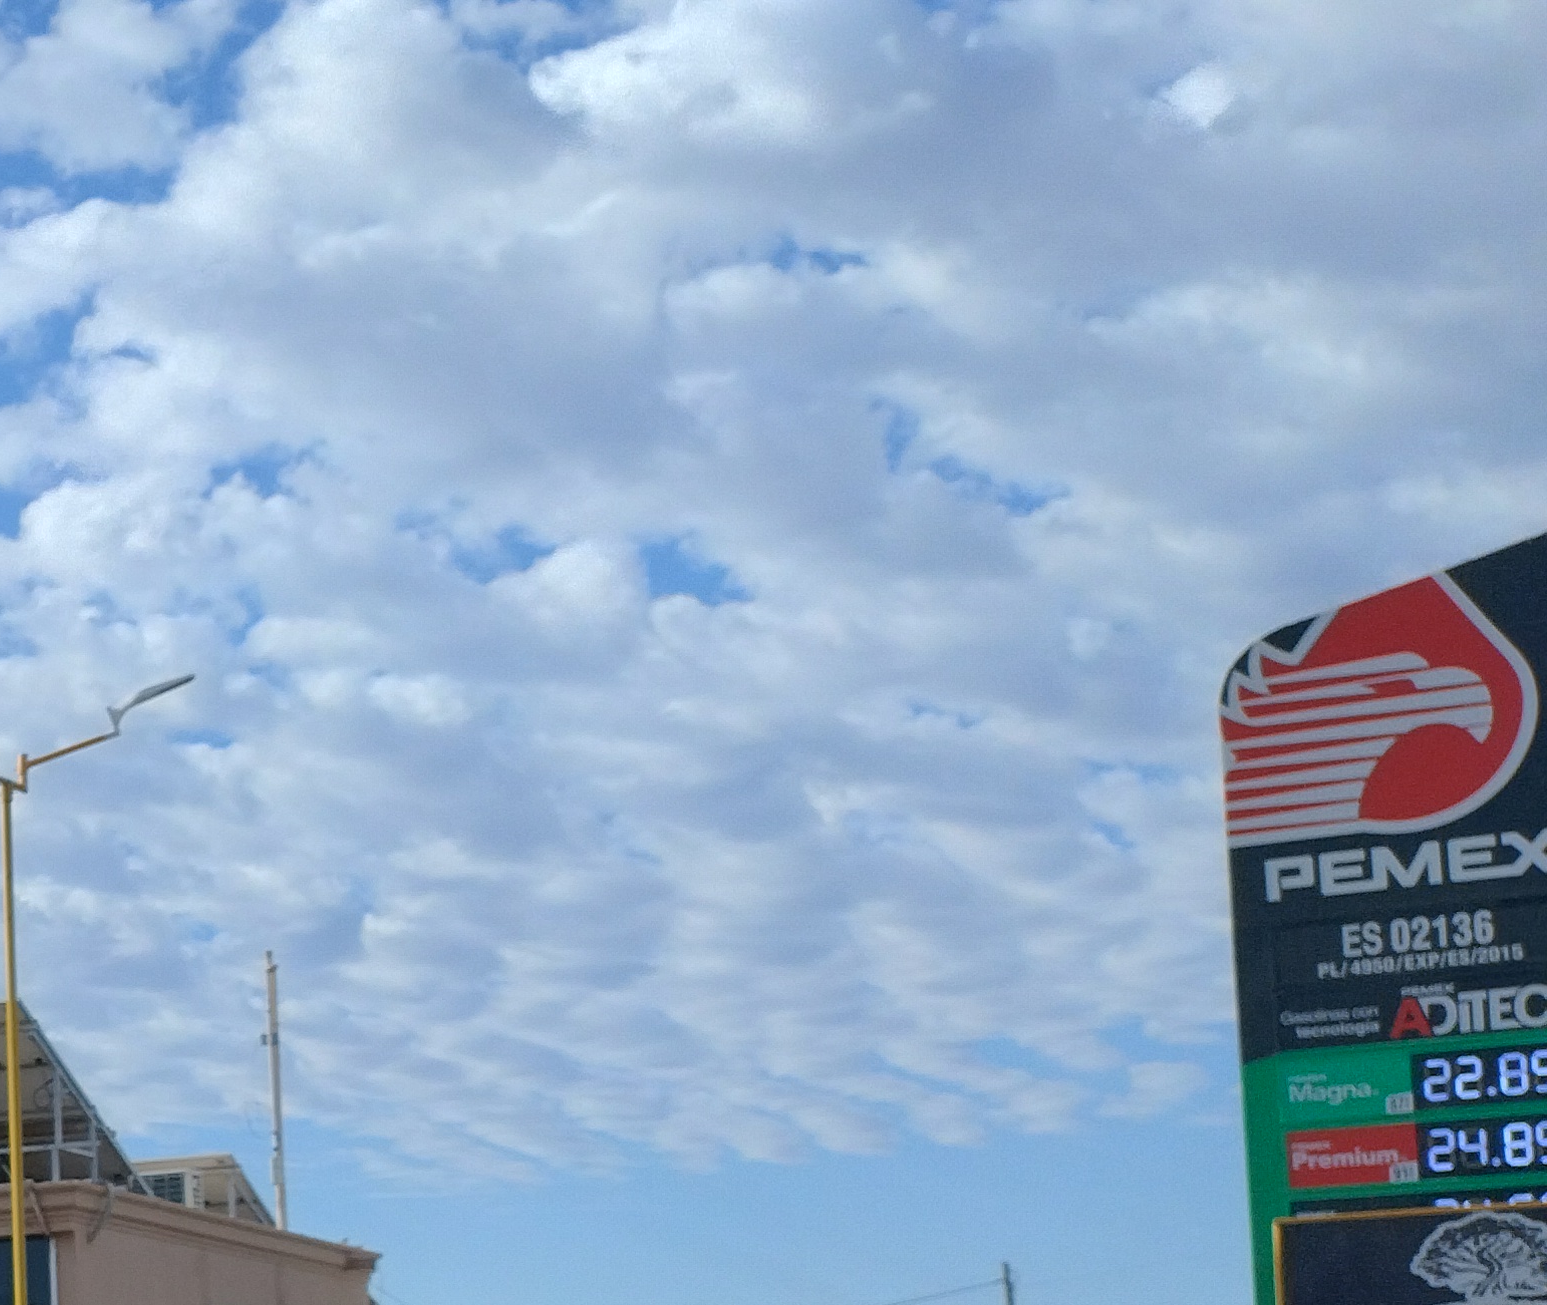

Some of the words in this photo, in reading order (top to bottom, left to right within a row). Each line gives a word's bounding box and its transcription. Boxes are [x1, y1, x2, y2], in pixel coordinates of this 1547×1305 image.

[1264, 828, 1547, 903] PEMEX
[1341, 920, 1384, 958] ES
[1389, 908, 1496, 954] 02136
[1292, 1146, 1399, 1172] Premium
